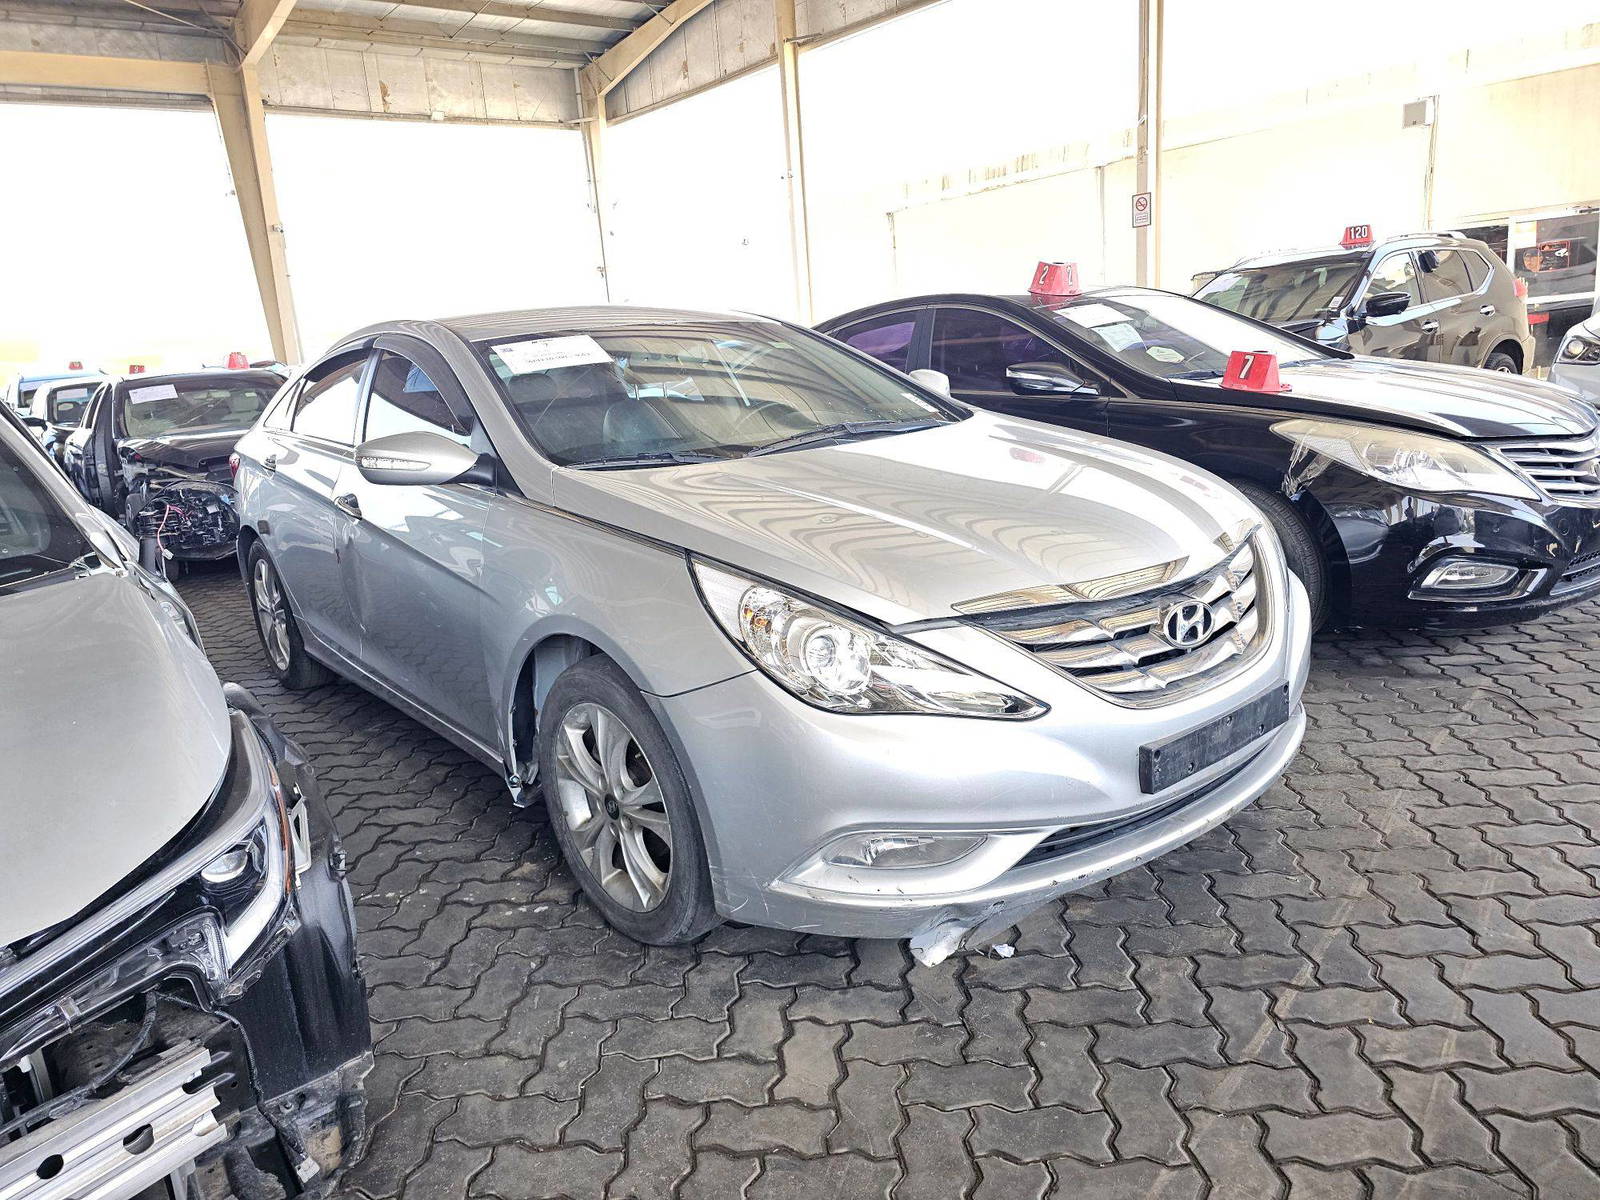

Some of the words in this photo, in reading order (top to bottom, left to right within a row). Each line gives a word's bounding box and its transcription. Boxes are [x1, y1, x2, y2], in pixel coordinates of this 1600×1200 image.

[1350, 226, 1368, 240] 120
[1039, 265, 1049, 285] 2
[1239, 354, 1255, 379] 7
